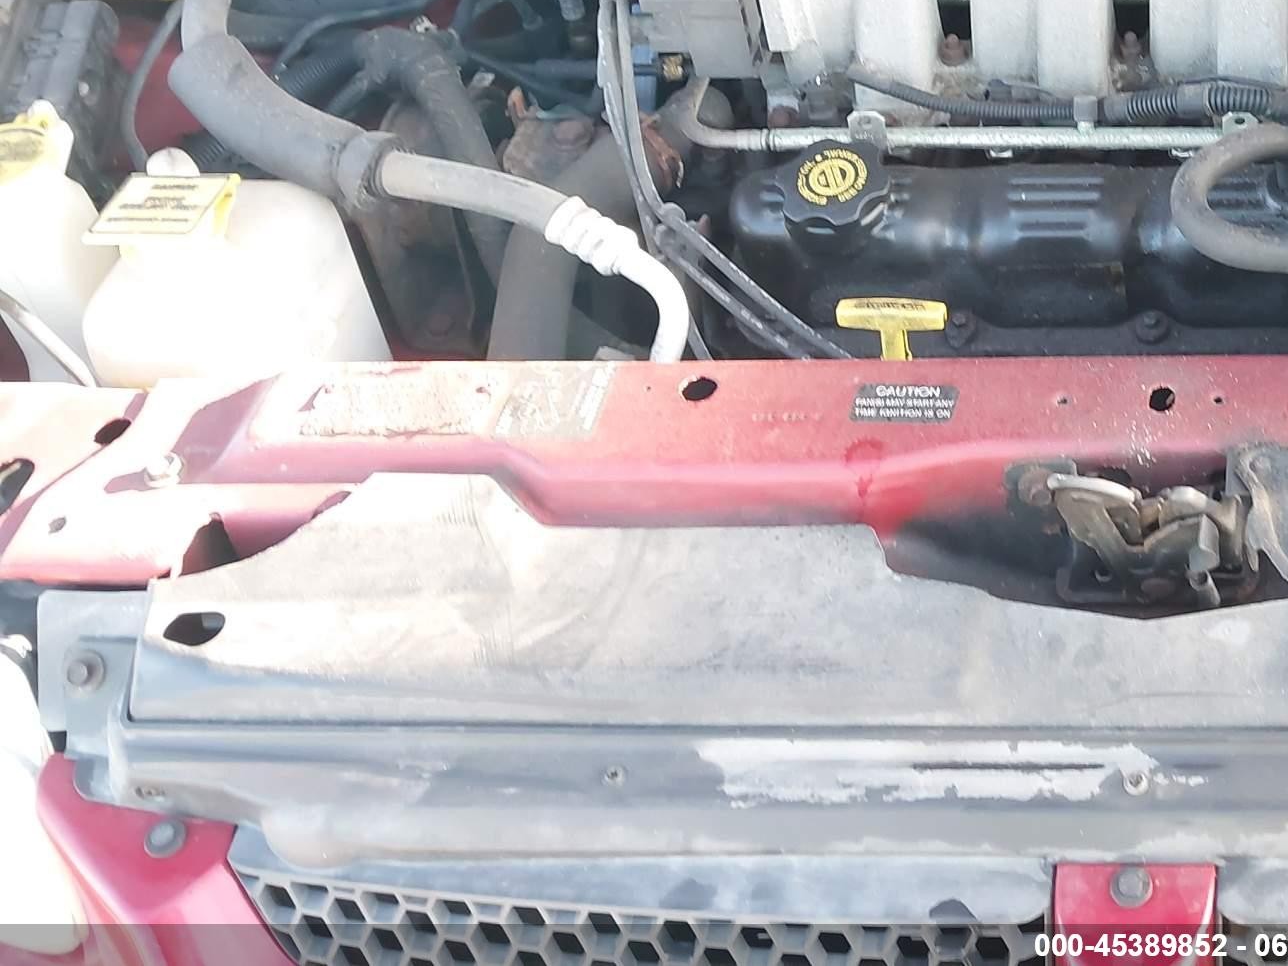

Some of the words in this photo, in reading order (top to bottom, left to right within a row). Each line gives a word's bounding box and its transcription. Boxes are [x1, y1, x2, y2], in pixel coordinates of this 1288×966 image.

[876, 385, 941, 397] CAUTION
[886, 398, 905, 407] MAY
[906, 398, 934, 408] START
[935, 399, 954, 408] ANY
[855, 407, 876, 417] TIME
[879, 407, 922, 418] IGNITION
[935, 409, 951, 418] ON
